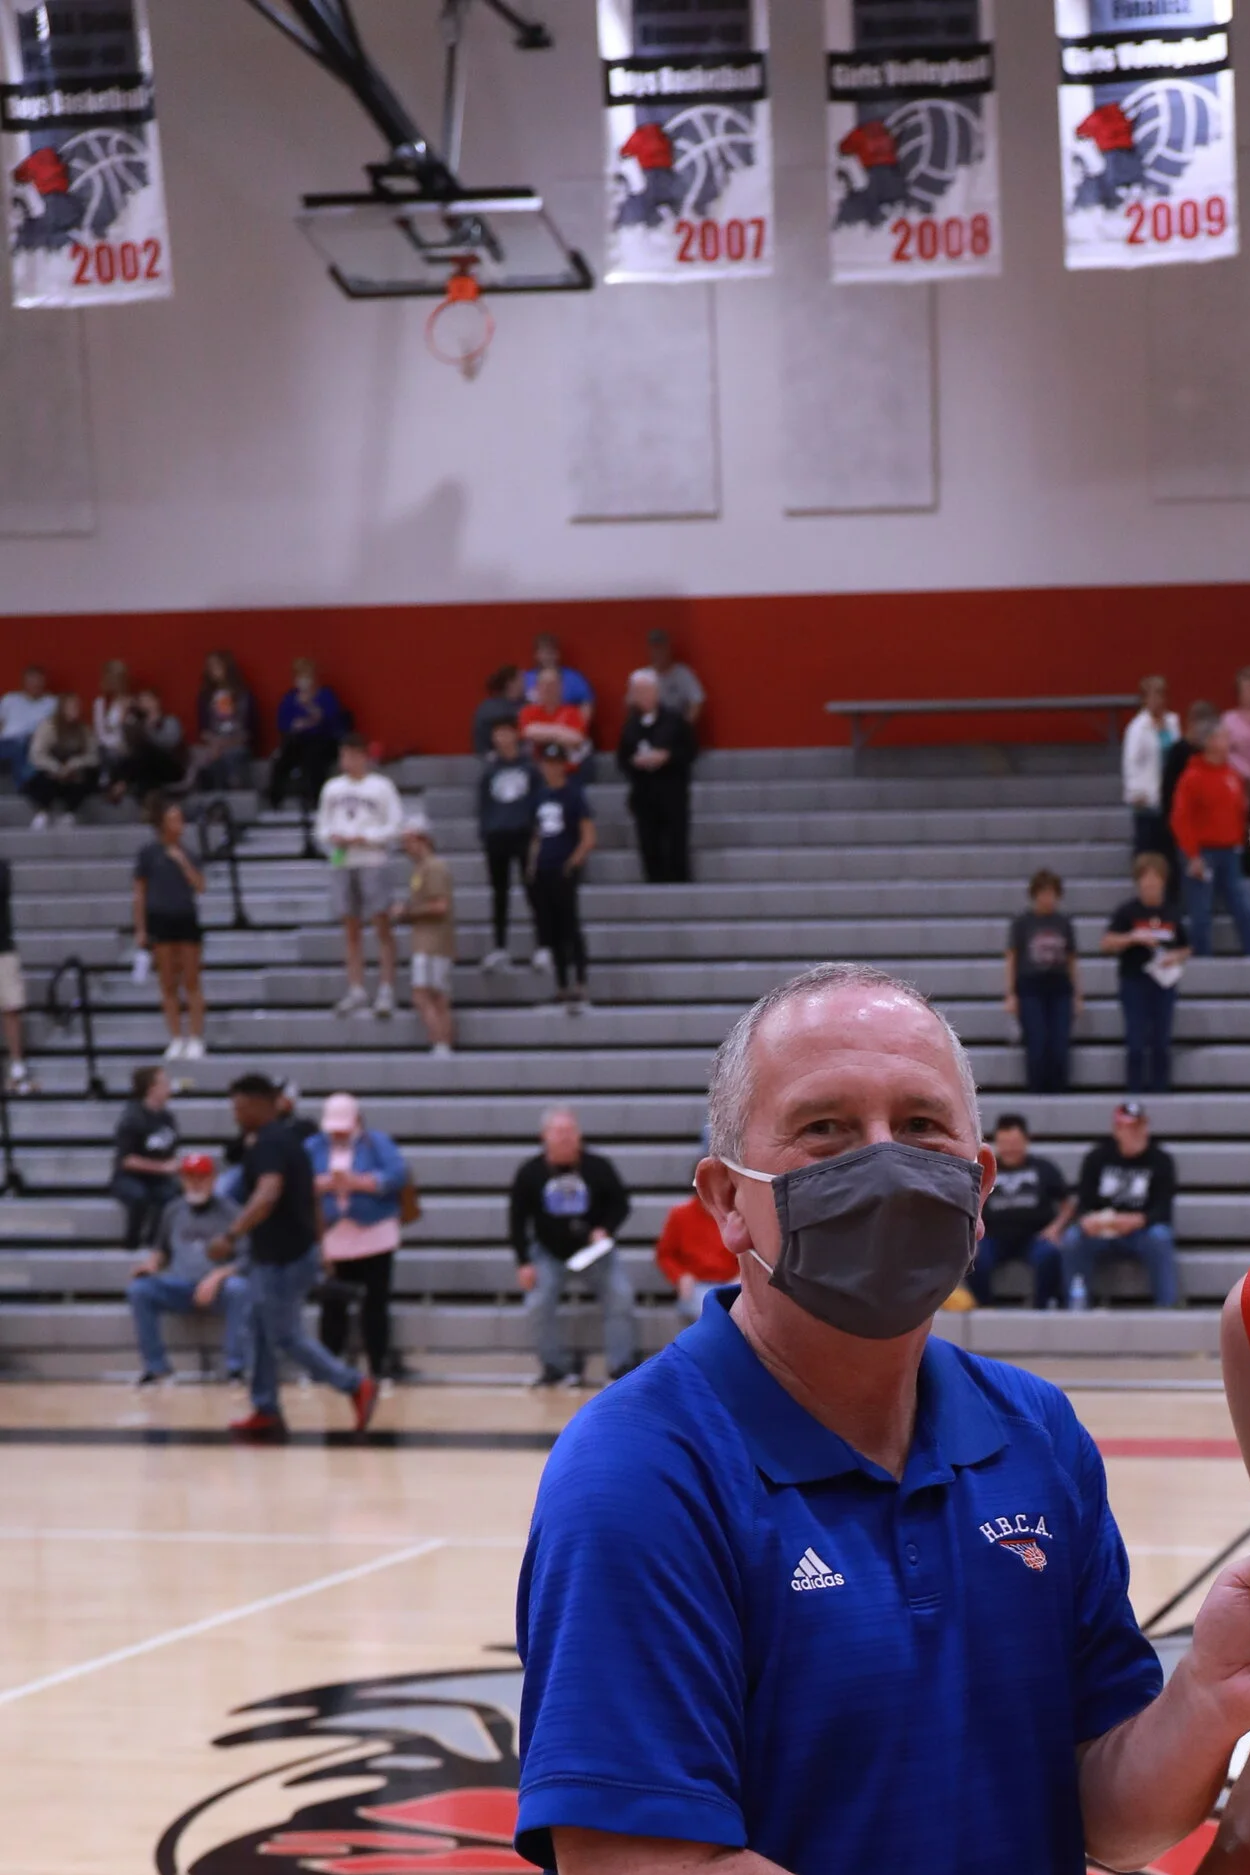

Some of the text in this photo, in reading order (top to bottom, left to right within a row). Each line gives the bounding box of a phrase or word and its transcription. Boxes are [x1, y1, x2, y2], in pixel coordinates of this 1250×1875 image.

[674, 217, 767, 264] 2007
[890, 213, 991, 263] 2008
[1125, 195, 1227, 245] 2009
[70, 236, 161, 286] 2002
[791, 1571, 845, 1591] adidas
